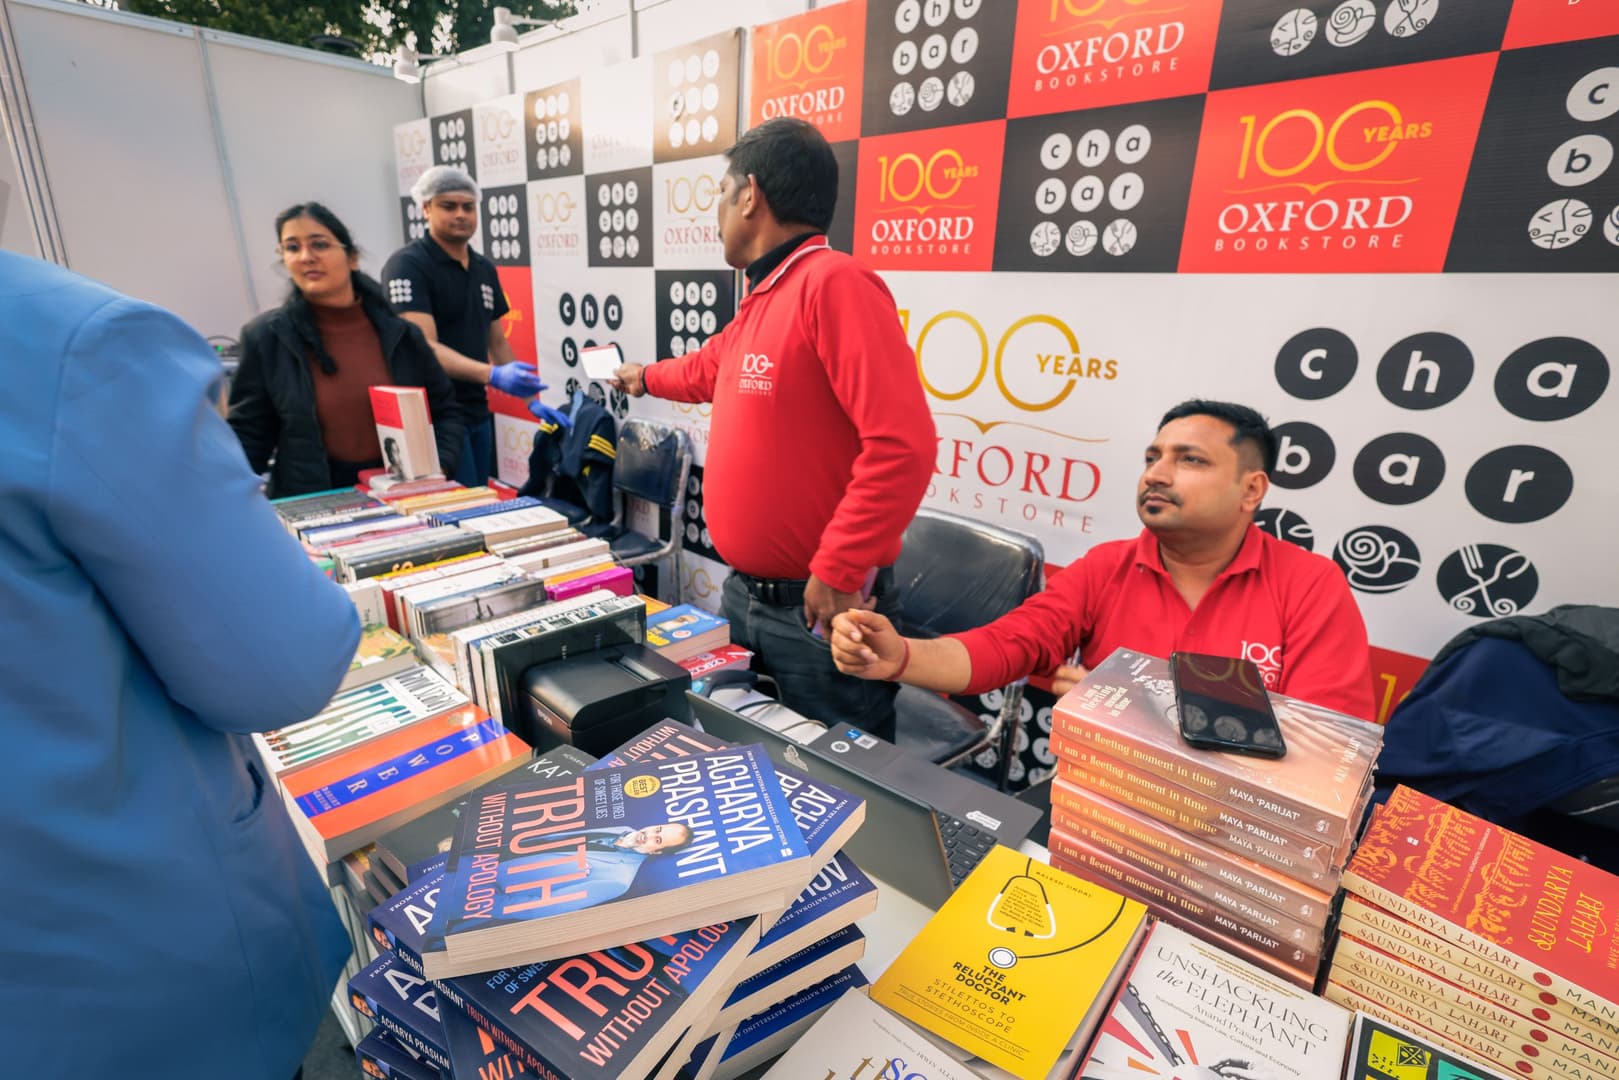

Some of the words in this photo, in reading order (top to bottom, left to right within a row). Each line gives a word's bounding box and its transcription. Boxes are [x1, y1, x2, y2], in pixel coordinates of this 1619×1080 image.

[766, 25, 834, 81] 100
[1036, 22, 1185, 74] OXFORD
[1034, 56, 1179, 92] BOOKSTORE
[760, 86, 846, 122] OXFORD
[1238, 99, 1403, 181] 100
[1363, 122, 1433, 144] YEARS
[877, 148, 963, 203] 100
[943, 164, 979, 180] YEARS
[665, 175, 716, 213] 100
[1043, 184, 1132, 205] bar
[1218, 195, 1413, 234] OXFORD
[537, 233, 580, 249] OXFORD
[870, 216, 975, 242] OXFORD
[870, 242, 972, 256] BOOKSTORE
[1214, 233, 1404, 253] BOOKSTORE
[1037, 353, 1119, 381] YEARS
[1299, 347, 1578, 399] cha
[935, 437, 1101, 502] FORD
[623, 725, 679, 760] WITHOUT
[1068, 724, 1082, 736] am
[1094, 732, 1130, 756] fleeting
[1133, 750, 1174, 771] moment
[1177, 766, 1188, 777] in
[1192, 771, 1217, 788] time
[1064, 746, 1079, 758] am
[1089, 754, 1124, 779] fleeting
[1127, 772, 1166, 795] moment
[1169, 789, 1180, 801] in
[1183, 796, 1208, 813] time
[1229, 787, 1254, 803] MAYA
[474, 792, 507, 849] WITHOUT
[660, 760, 727, 879] PRASHANT
[705, 755, 775, 855] ACHARYA
[1073, 768, 1088, 779] am
[1098, 777, 1134, 801] fleeting
[1136, 795, 1176, 817] moment
[1180, 811, 1190, 823] in
[1193, 818, 1217, 835] time
[1219, 812, 1243, 829] MAYA
[502, 777, 589, 915] TRUTH
[1065, 819, 1080, 831] am
[1090, 830, 1125, 854] fleeting
[1126, 849, 1164, 873] moment
[1167, 867, 1177, 879] in
[1180, 874, 1204, 890] time
[1228, 834, 1254, 851] MAYA
[463, 852, 501, 920] APOLOGY
[828, 889, 841, 898] THE
[844, 880, 860, 891] FROM
[1063, 846, 1078, 857] am
[1089, 856, 1123, 880] fleeting
[1125, 875, 1164, 898] moment
[1166, 891, 1177, 904] in
[1180, 899, 1204, 915] time
[1219, 868, 1243, 885] MAYA
[389, 899, 411, 912] FROM
[412, 885, 429, 897] THE
[794, 895, 828, 915] NATIONAL
[1214, 891, 1237, 908] MAYA
[1527, 864, 1574, 952] SAUNDARYA
[1214, 915, 1238, 932] MAYA
[1358, 883, 1448, 935] SAUNDARYA
[1458, 932, 1521, 971] LAHARI
[369, 959, 392, 979] FROM
[1357, 927, 1448, 975] SAUNDARYA
[1457, 974, 1521, 1010] LAHARI
[1361, 912, 1452, 960] SAUNDARYA
[1463, 956, 1526, 992] LAHARI
[486, 969, 511, 990] FOR
[504, 979, 519, 994] OF
[819, 983, 834, 993] THE
[834, 973, 852, 984] FROM
[952, 961, 1027, 1002] RELUCTANT
[955, 973, 1011, 1006] DOCTOR
[983, 965, 1007, 982] THE
[787, 989, 820, 1011] NATIONAL
[925, 985, 1012, 1033] STETHOSCOPE
[934, 978, 995, 1014] STILETTOS
[1000, 1011, 1016, 1024] TO
[1156, 947, 1328, 1042] UNSHACKLING
[1156, 968, 1183, 987] the
[1186, 980, 1316, 1055] ELEPHANT
[1350, 962, 1439, 1011] SAUNDARYA
[1448, 1008, 1509, 1043] LAHARI
[1355, 949, 1446, 997] SAUNDARYA
[1455, 995, 1518, 1030] LAHARI
[1561, 1043, 1617, 1075] MANI
[466, 1003, 489, 1029] TRUTH
[490, 1021, 526, 1058] WITHOUT
[579, 977, 672, 1067] WITHOUT
[1193, 1003, 1227, 1026] Anand
[1228, 1020, 1263, 1045] Prasad
[1348, 979, 1434, 1027] SAUNDARYA
[1442, 1025, 1503, 1060] LAHARI
[381, 1015, 414, 1043] ACHARYA
[415, 1038, 451, 1070] PRASHAN
[1229, 1034, 1254, 1050] Culture
[1268, 1055, 1302, 1077] Economy
